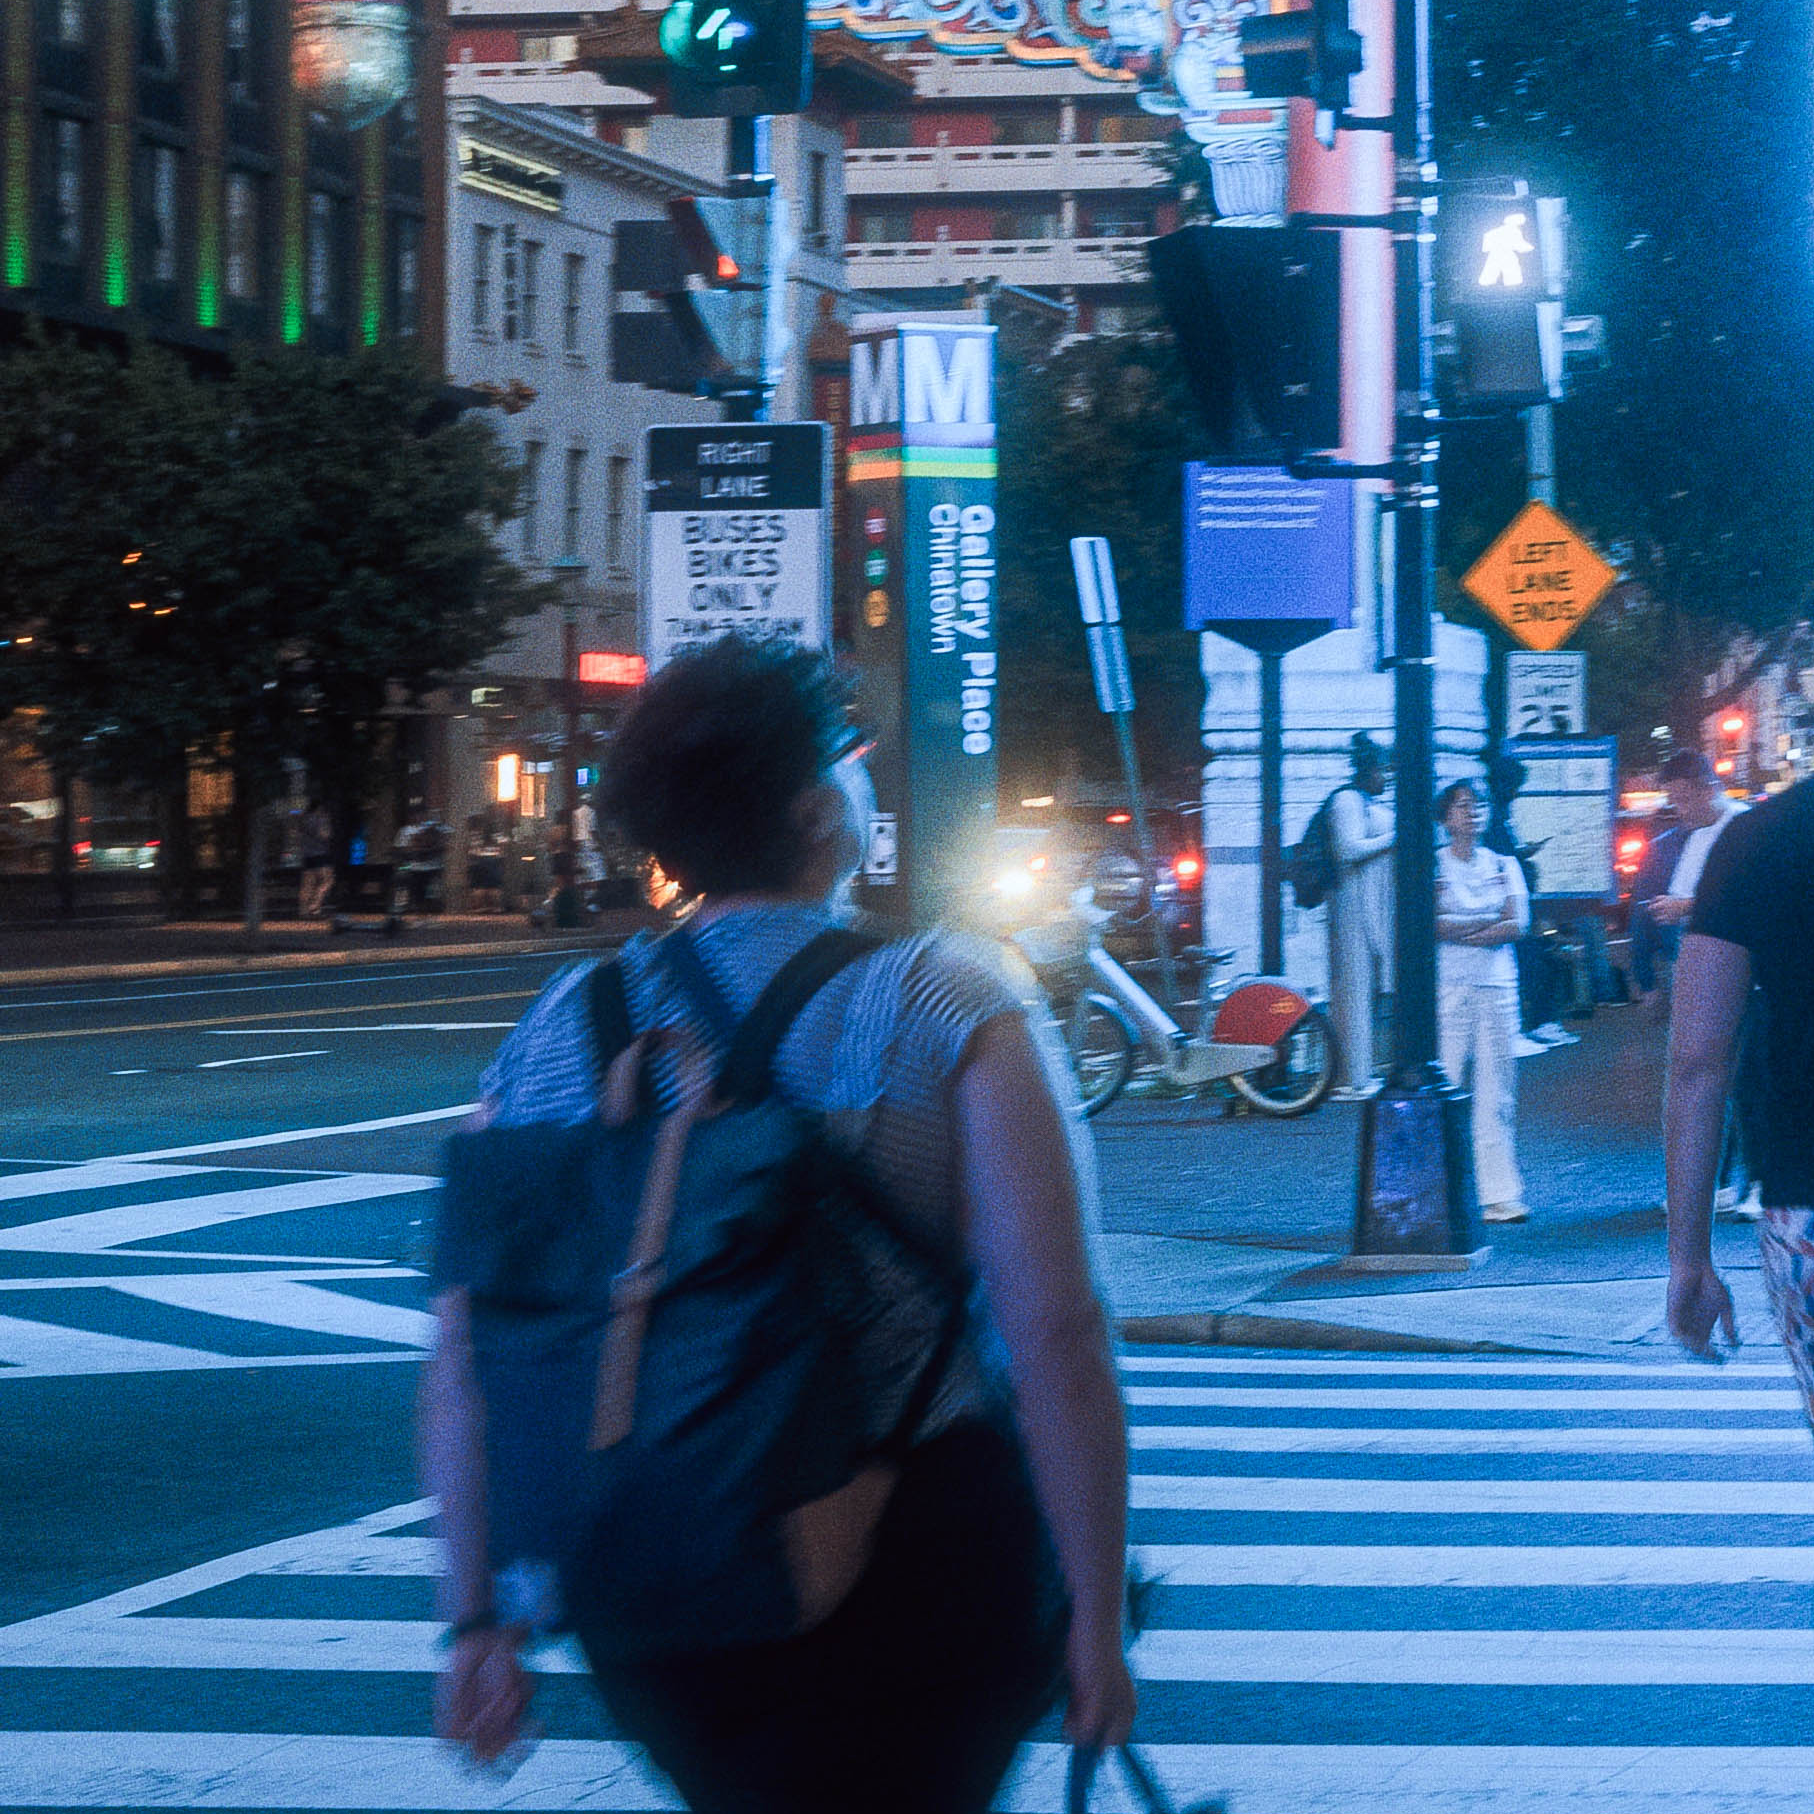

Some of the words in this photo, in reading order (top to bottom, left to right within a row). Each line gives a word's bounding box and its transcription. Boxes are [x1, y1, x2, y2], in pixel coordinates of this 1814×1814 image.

[903, 336, 991, 424] M
[697, 441, 773, 465] RIGHT
[701, 475, 771, 499] LANE
[682, 514, 787, 544] BUSES
[687, 548, 782, 577] BIKES
[1509, 541, 1568, 565] LEFT
[928, 503, 960, 653] Chinatown
[953, 504, 996, 639] Gallery
[1507, 570, 1573, 594] LANE
[688, 582, 780, 612] ONLY
[1511, 599, 1578, 624] ENDS
[961, 651, 997, 755] Place
[1519, 703, 1573, 735] 25
